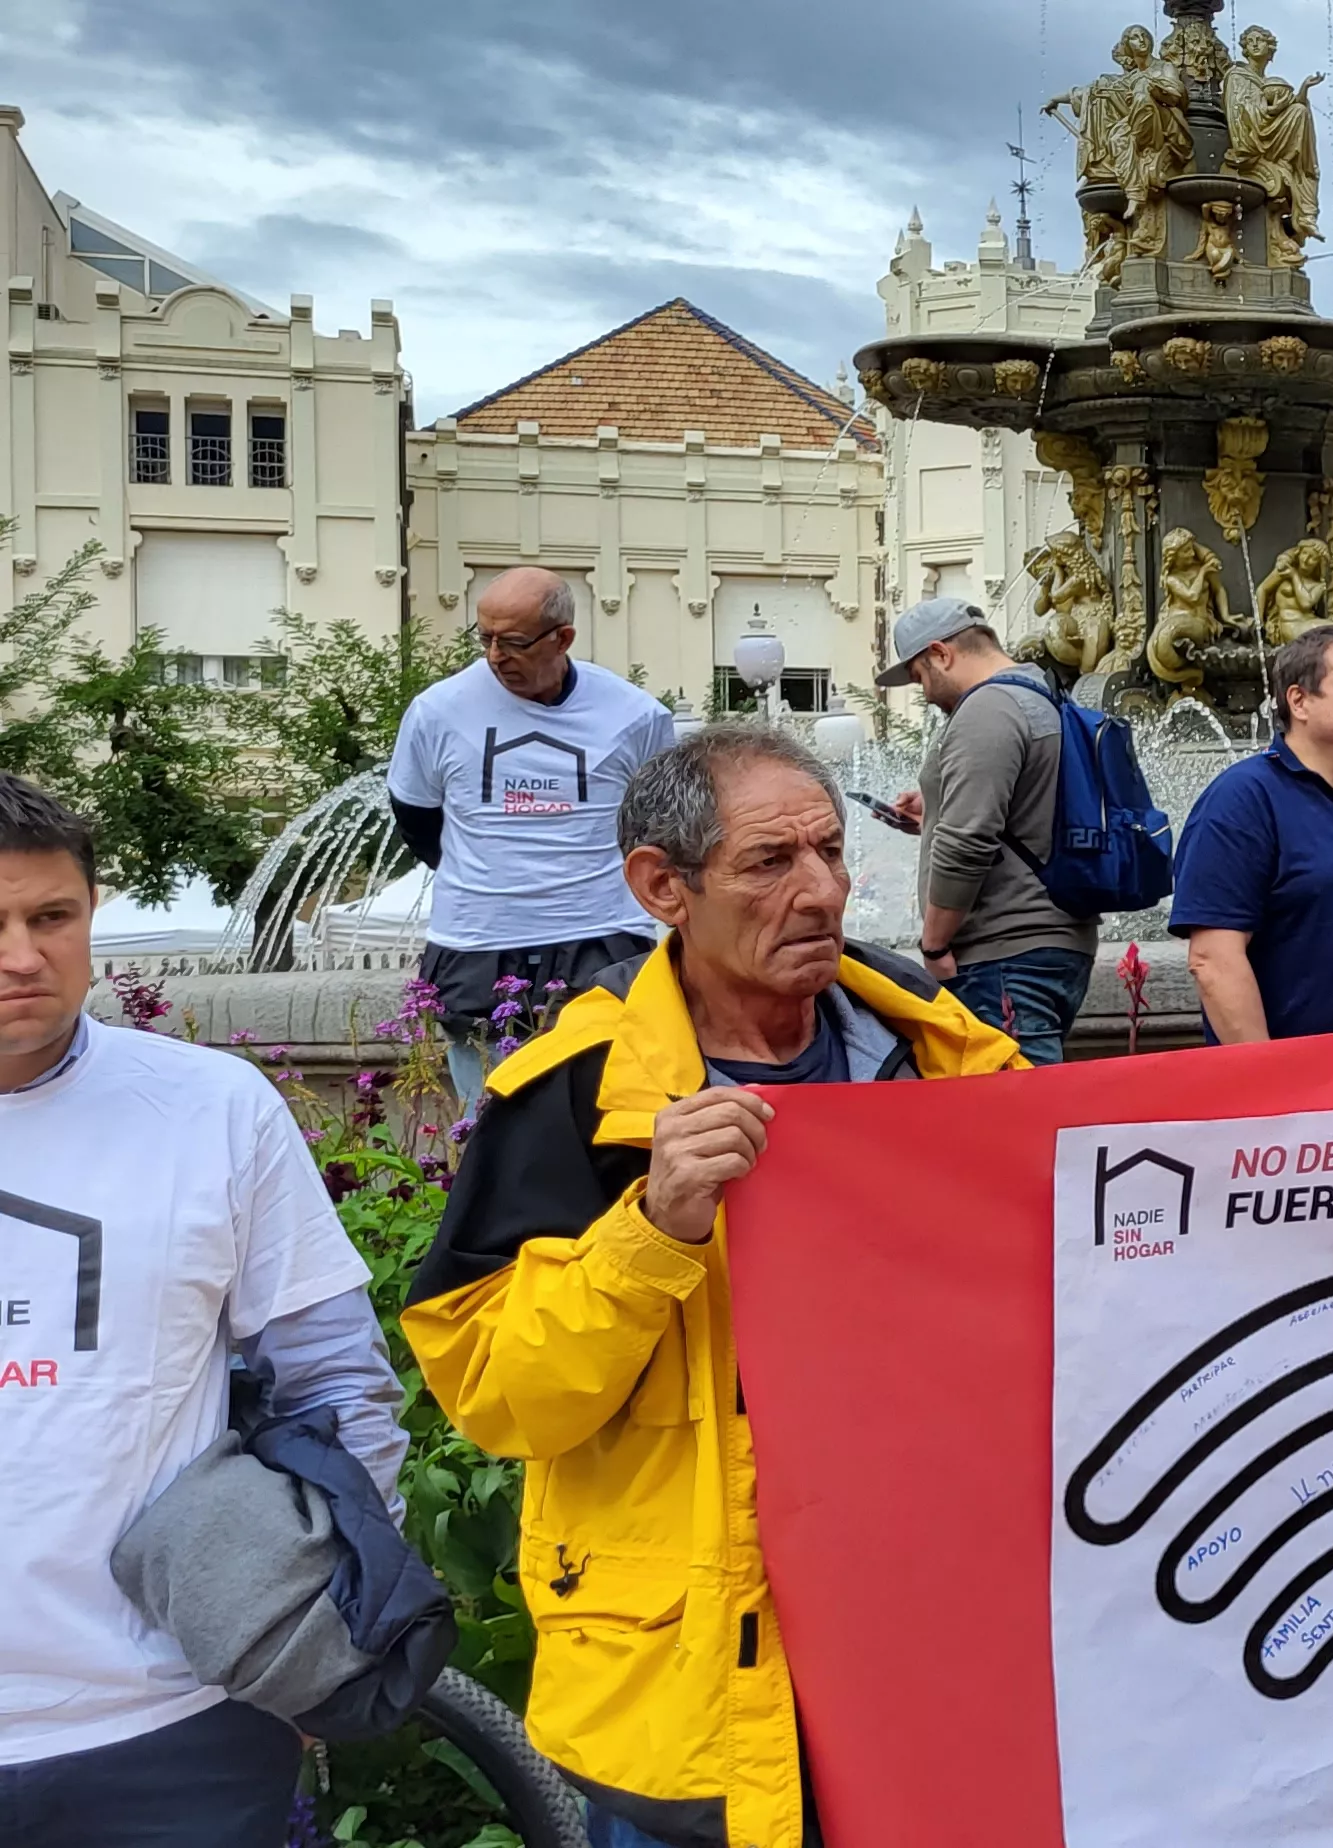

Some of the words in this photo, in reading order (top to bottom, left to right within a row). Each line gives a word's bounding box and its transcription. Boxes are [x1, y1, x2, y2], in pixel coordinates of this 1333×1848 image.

[504, 779, 560, 791] NADIE
[504, 791, 535, 804] SIN
[1231, 1145, 1288, 1180] NO
[1113, 1208, 1165, 1228] NADIE
[1113, 1227, 1142, 1245] SIN
[1113, 1241, 1175, 1262] HOGAR
[1187, 1527, 1242, 1571] APOYO
[1261, 1595, 1322, 1659] FAMILIA
